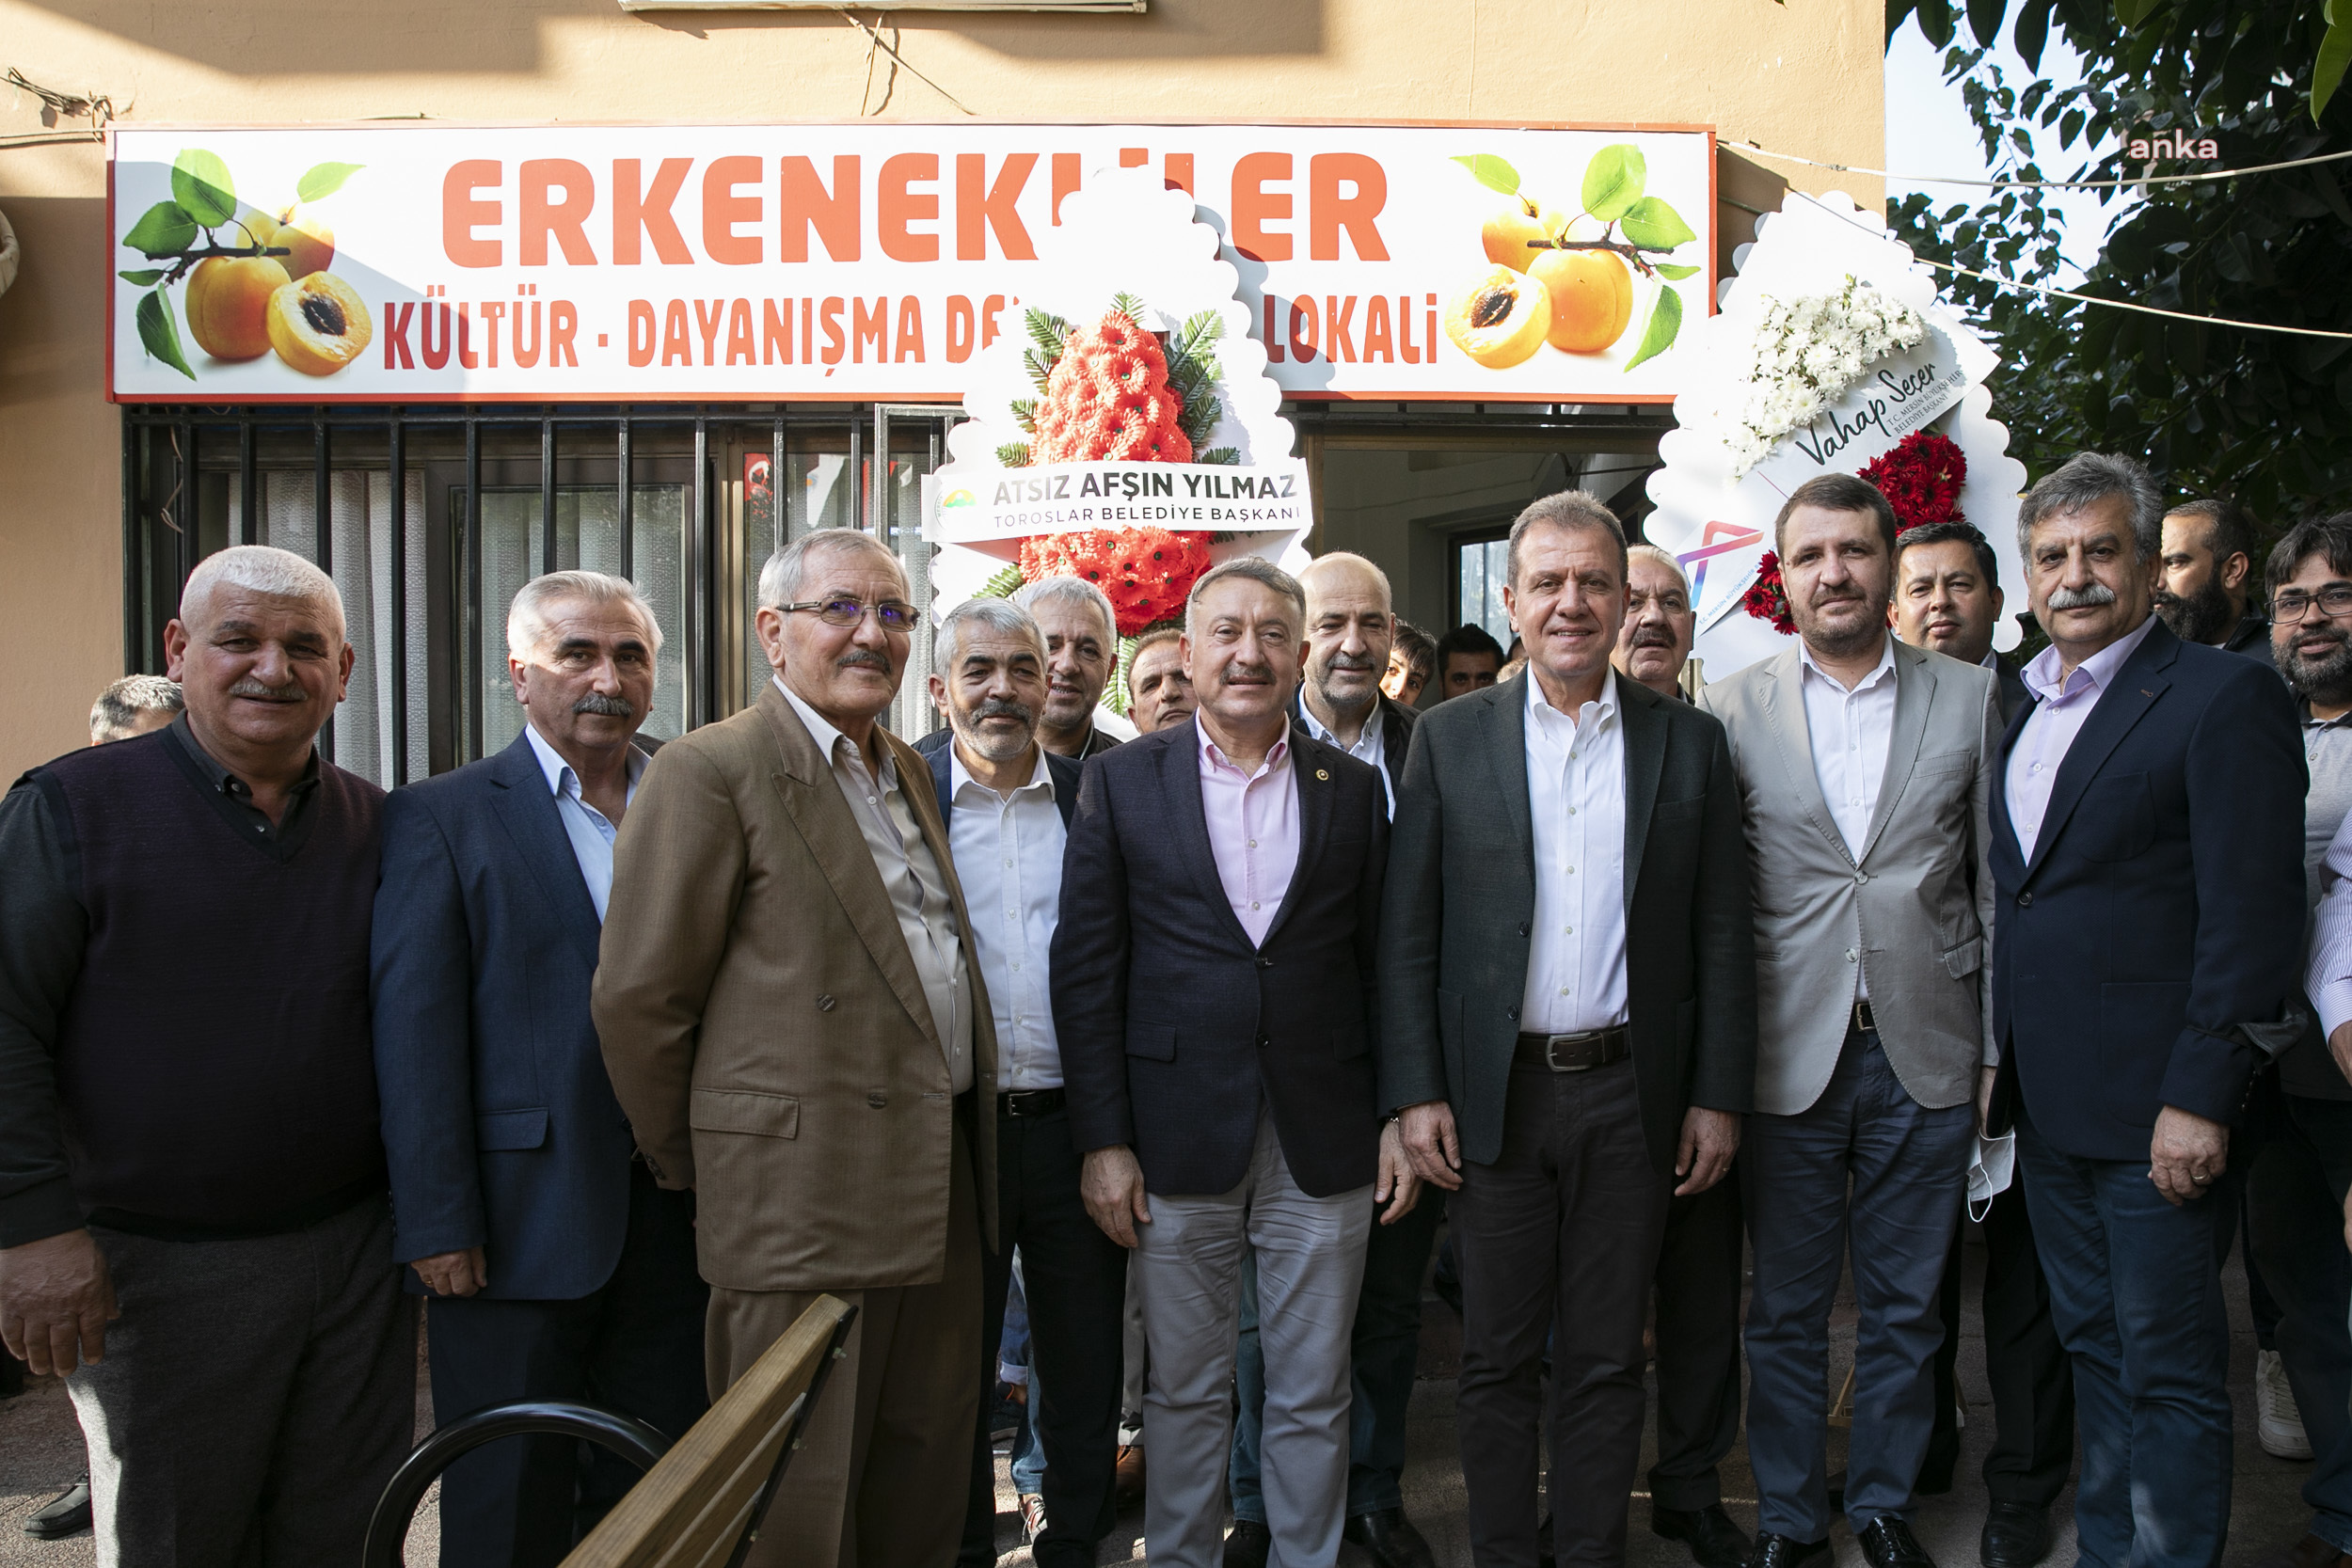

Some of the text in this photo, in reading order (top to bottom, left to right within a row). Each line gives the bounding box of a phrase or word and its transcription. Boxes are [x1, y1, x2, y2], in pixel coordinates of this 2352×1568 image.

[442, 148, 1391, 268] ERKENEKER
[384, 284, 579, 370] KÜLTÜR
[628, 295, 926, 376] DAYANIŞMA
[1263, 293, 1437, 364] LOKALİ
[1795, 363, 1935, 466] Vahap Seçer
[1886, 370, 1963, 426] T.C. MERSİN BÜYÜKŞEHİR
[1894, 393, 1948, 434] BELEDİYE BAŞKANI
[993, 471, 1297, 505] ATSIZ AFŞIN YILMAZ
[994, 504, 1299, 528] TOROSLAR BELEDİYE BAŞKANI
